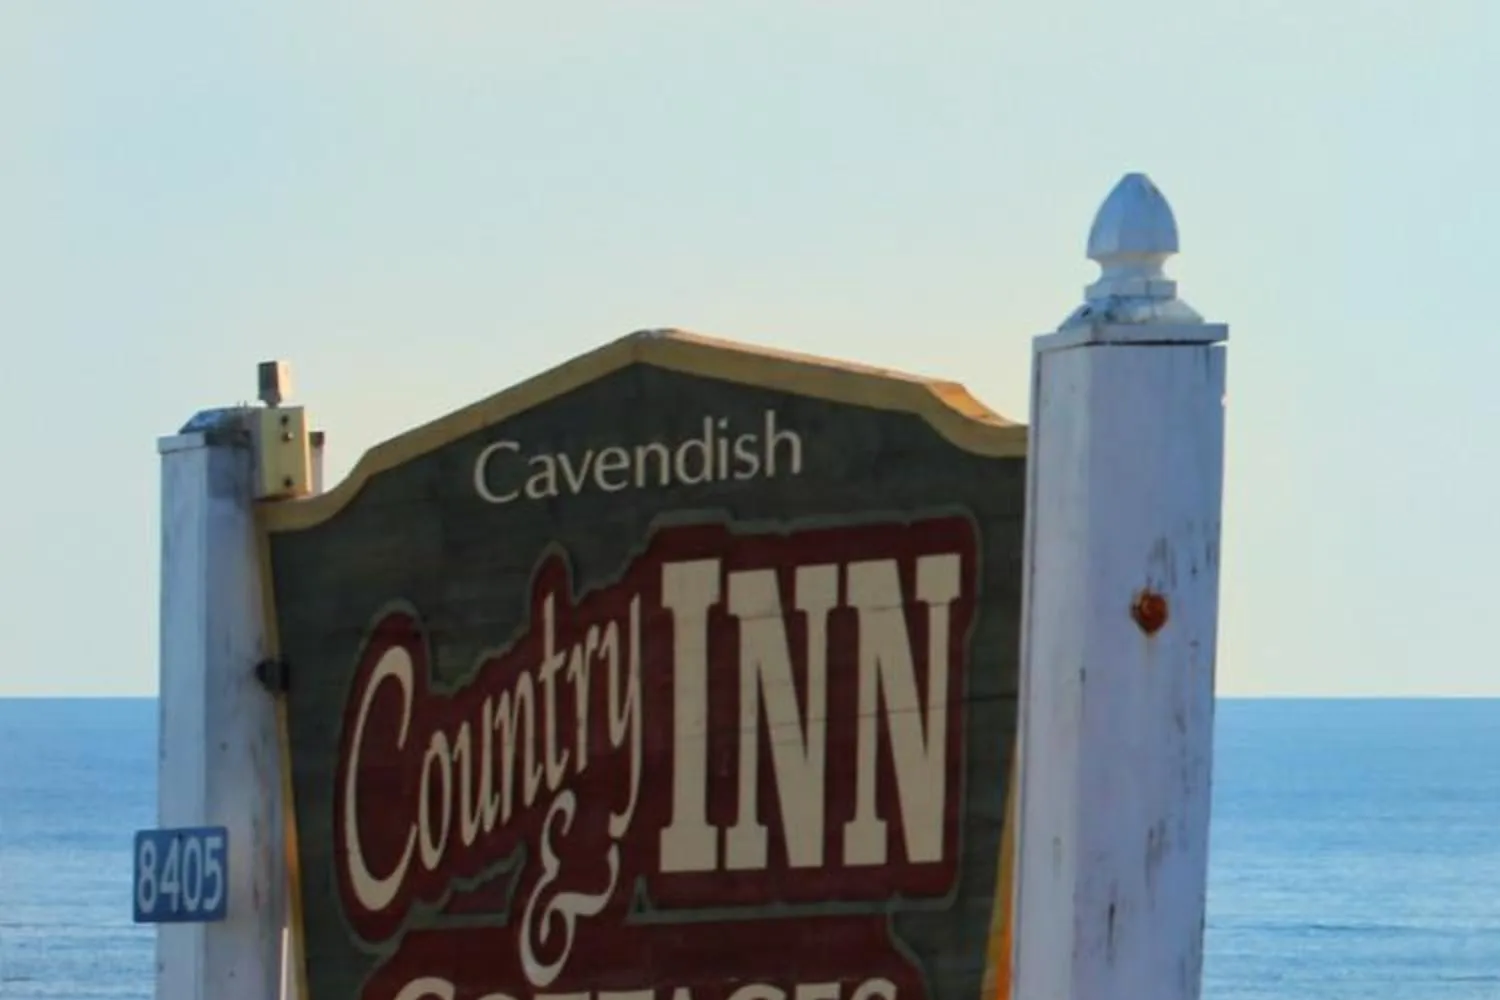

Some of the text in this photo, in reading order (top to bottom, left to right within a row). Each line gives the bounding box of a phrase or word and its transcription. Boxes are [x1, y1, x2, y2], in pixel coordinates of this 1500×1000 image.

[474, 411, 803, 502] Cavendish
[346, 554, 960, 910] Country INN
[138, 836, 223, 914] 8405
[521, 791, 621, 985] &
